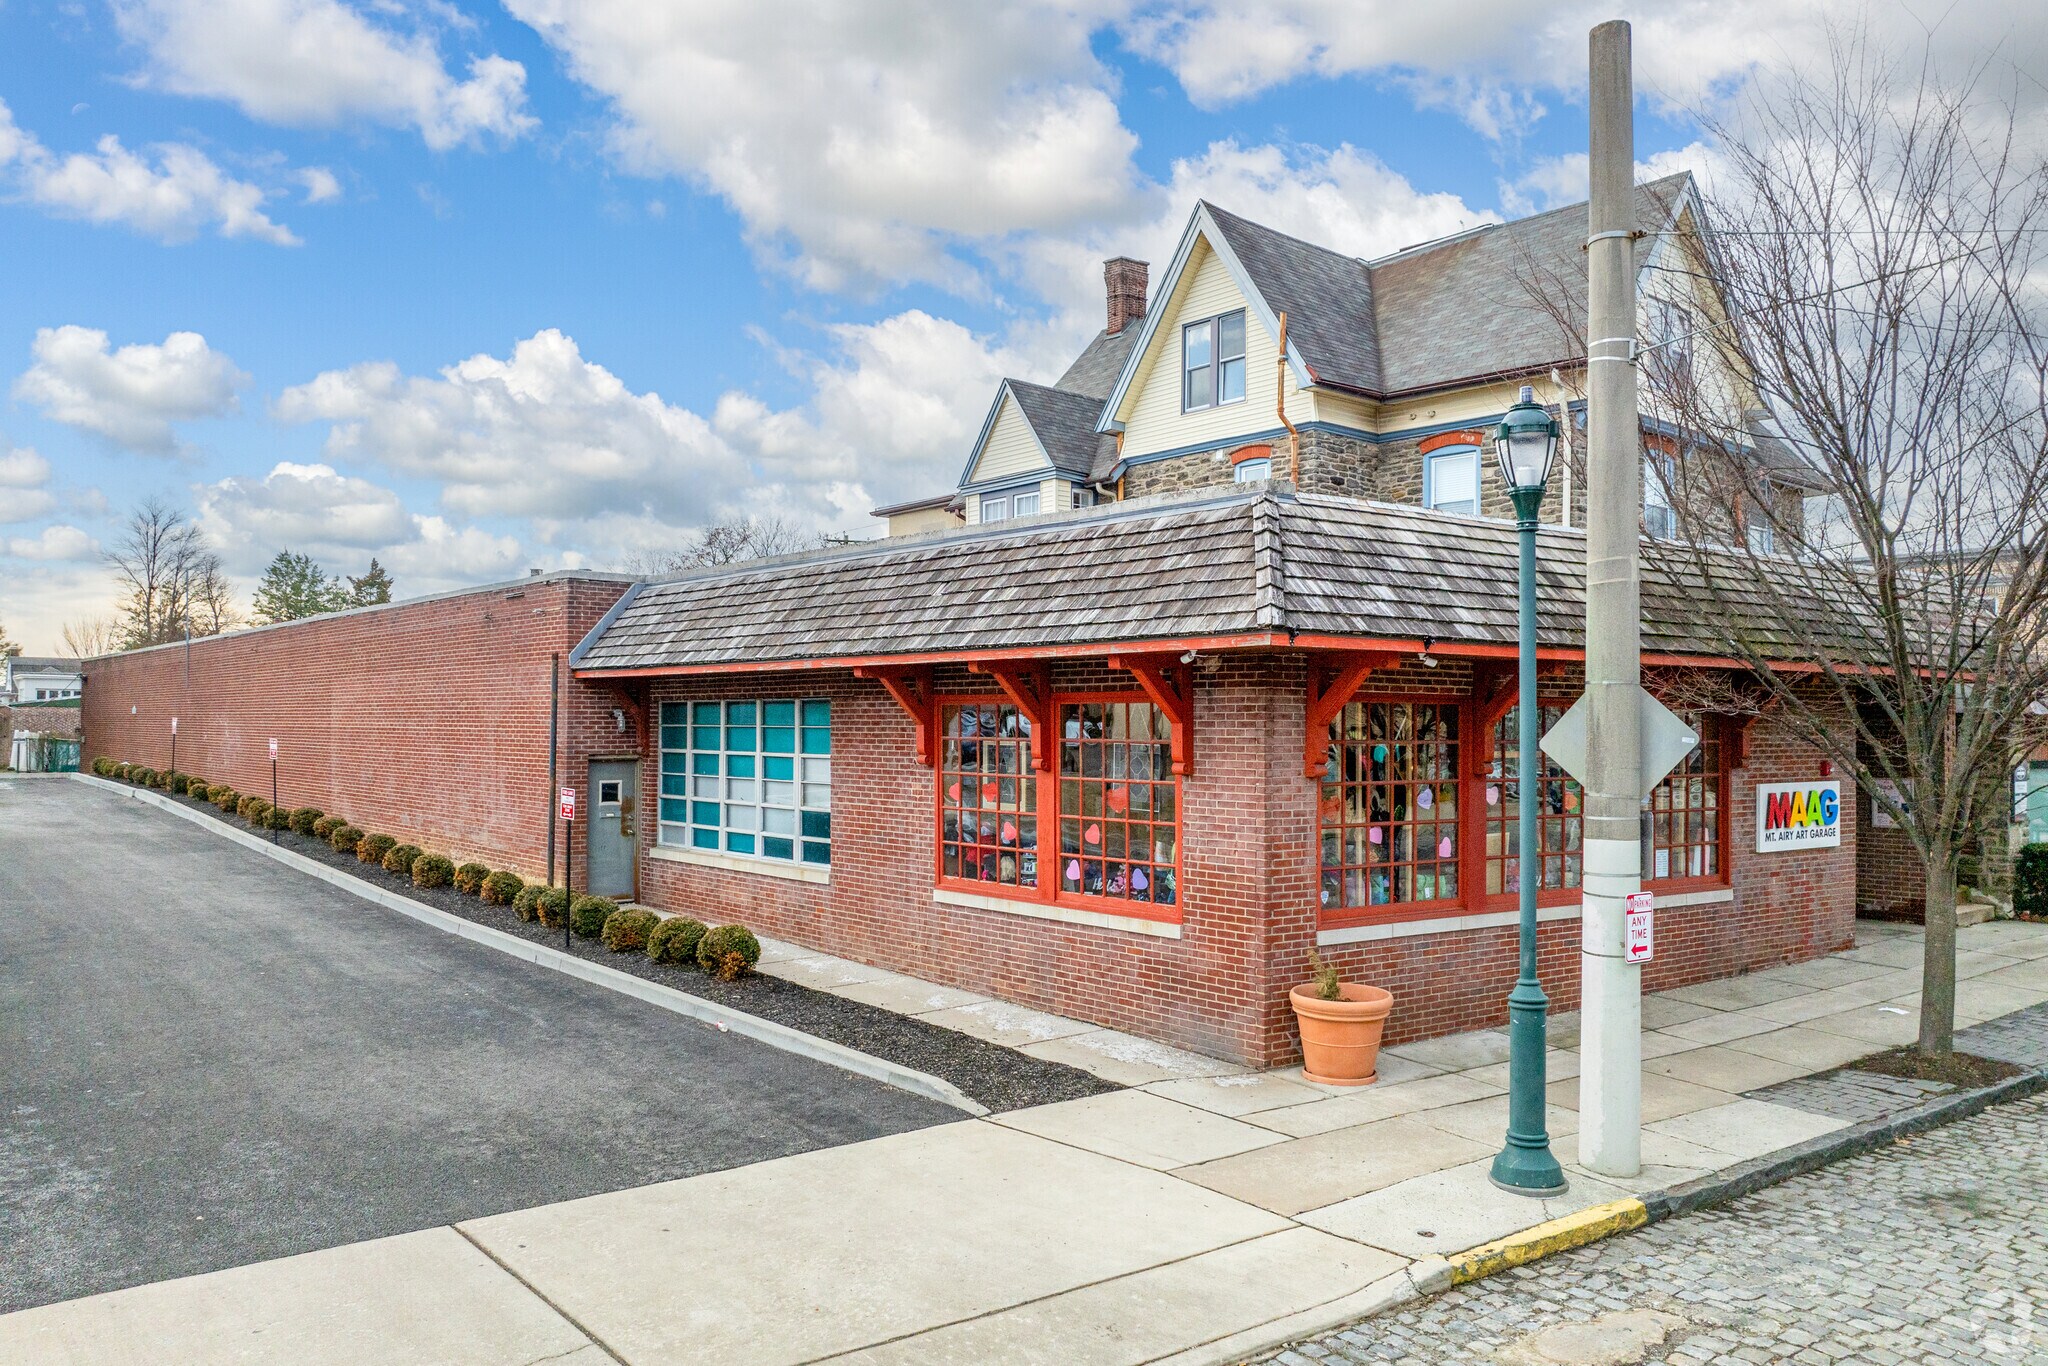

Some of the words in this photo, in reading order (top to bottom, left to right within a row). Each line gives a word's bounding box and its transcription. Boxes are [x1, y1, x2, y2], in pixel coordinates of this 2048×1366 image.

[1765, 789, 1839, 830] MAAG
[1765, 832, 1777, 842] MT.
[1778, 830, 1794, 841] AIRY
[1795, 829, 1808, 840] ART
[1809, 827, 1836, 839] GARAGE
[1634, 898, 1651, 909] PARKING
[1631, 915, 1647, 927] ANY
[1631, 928, 1648, 940] TIME
